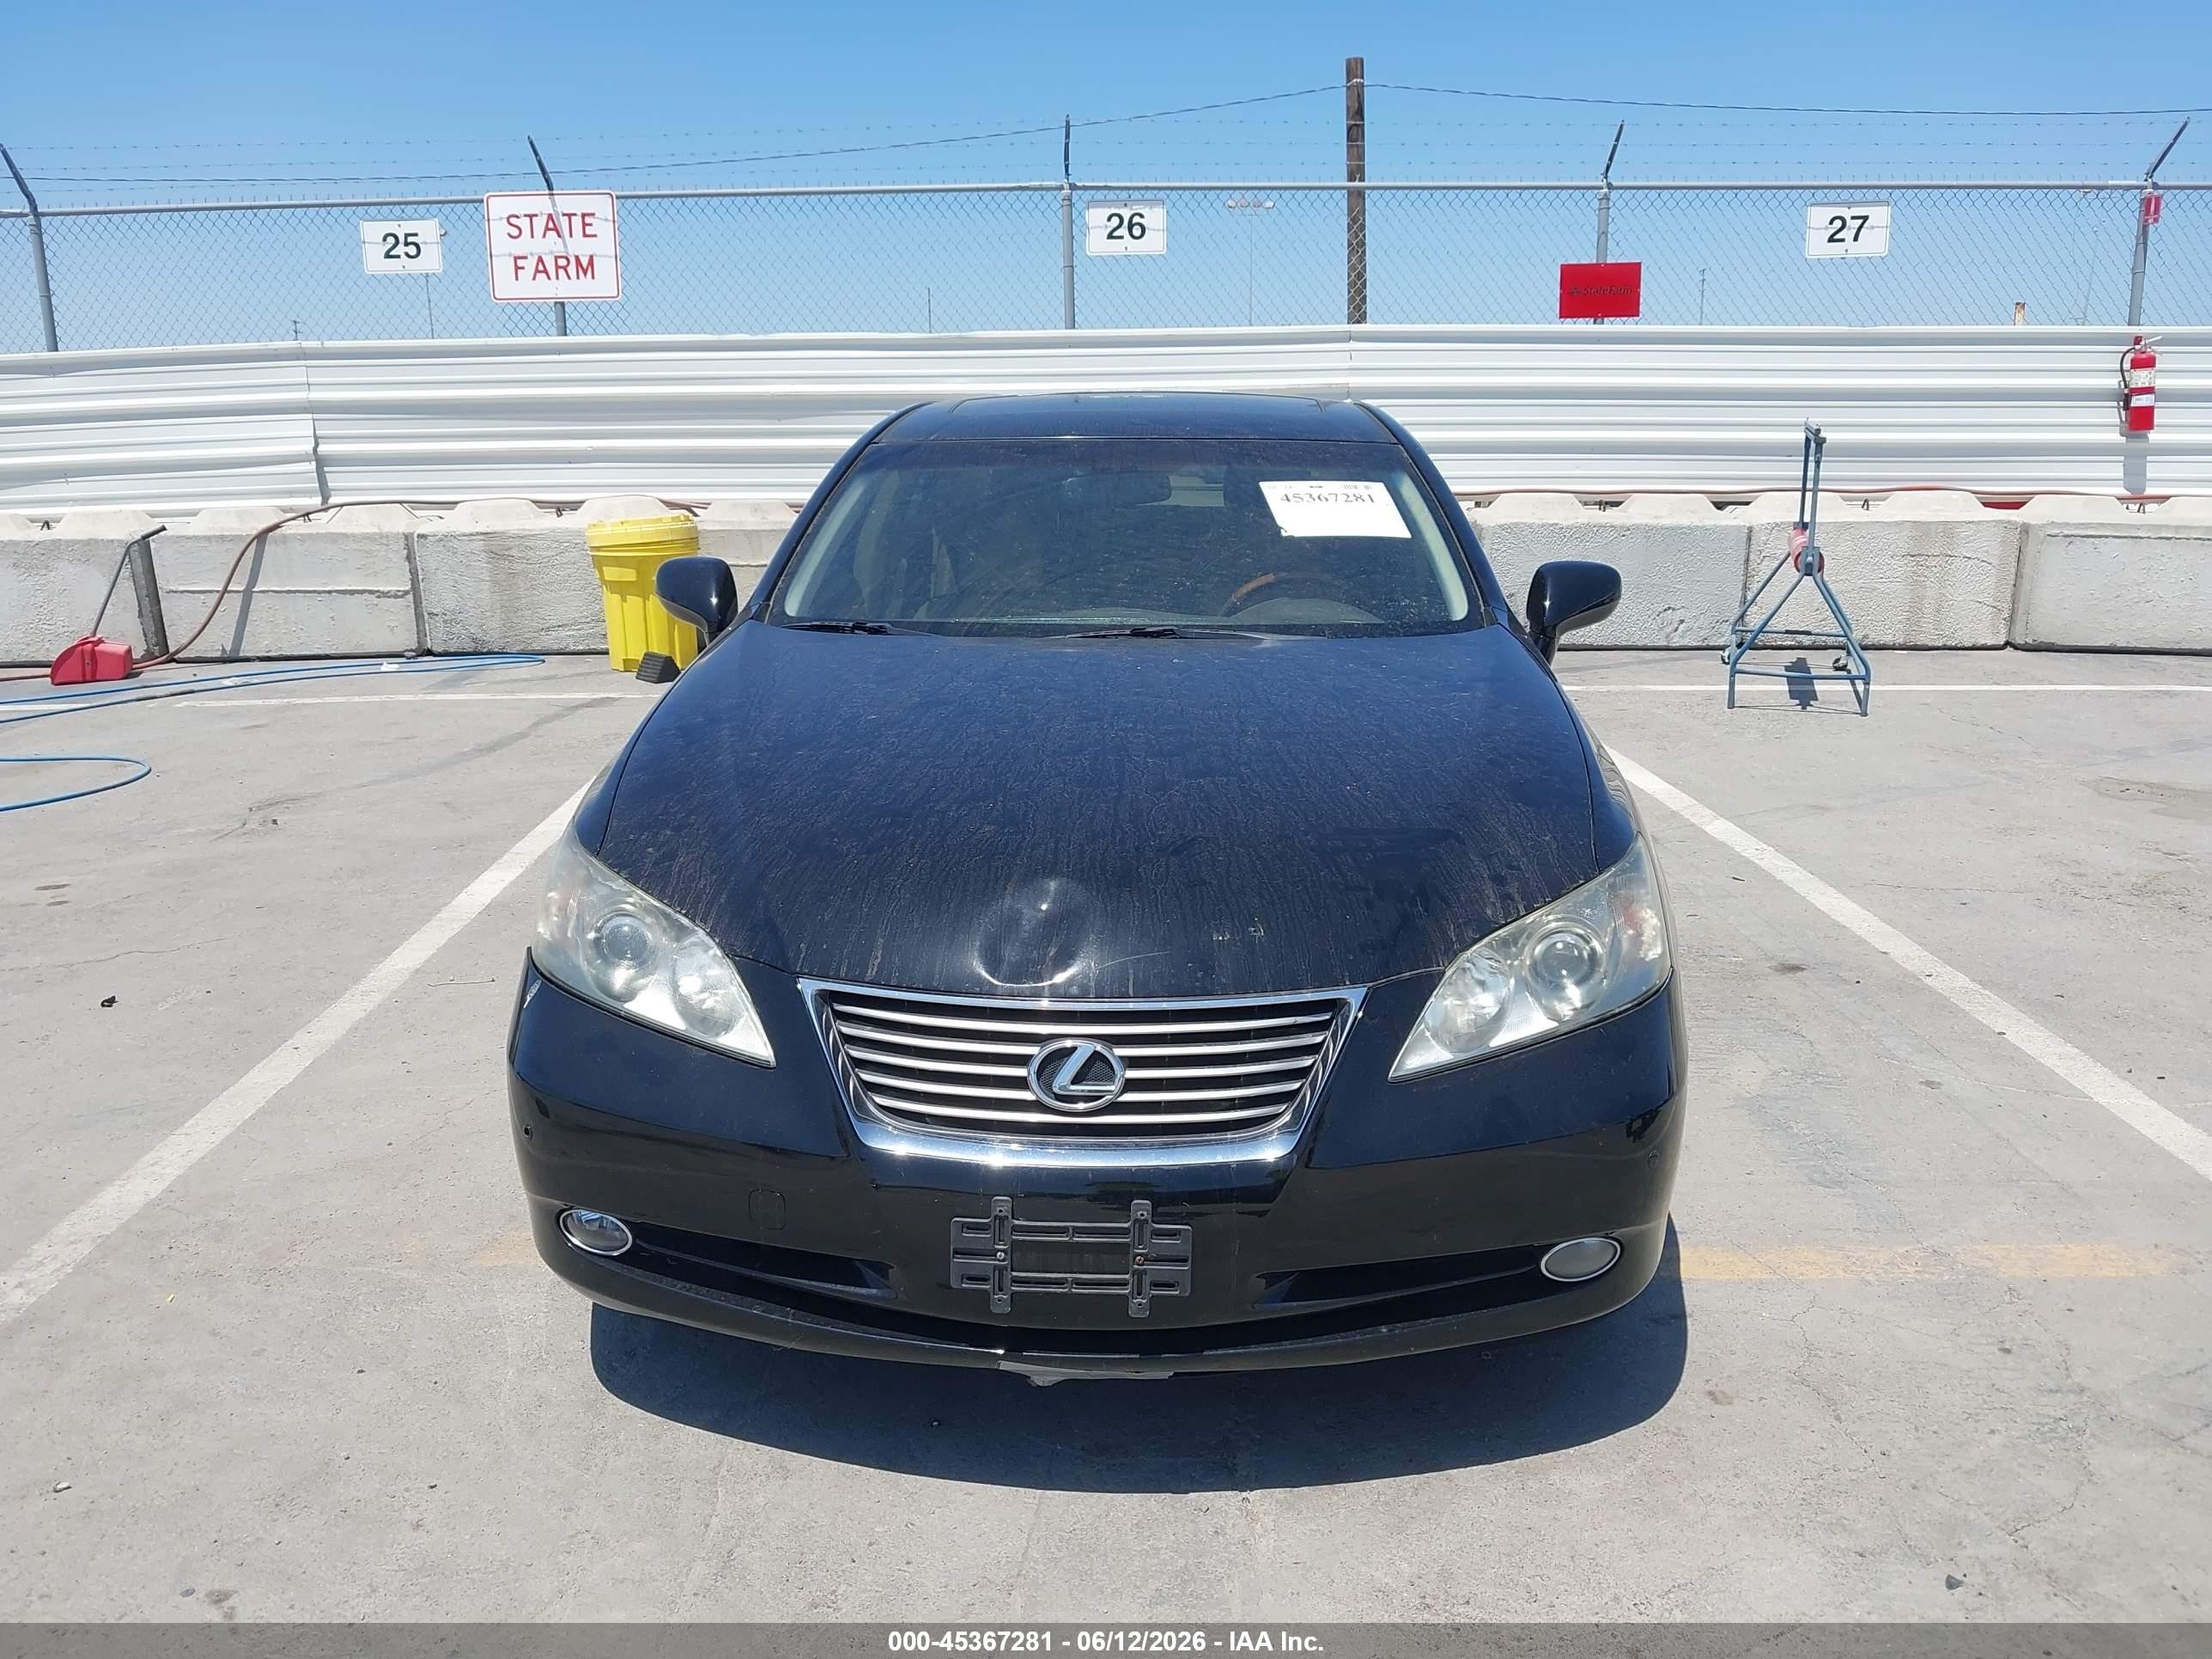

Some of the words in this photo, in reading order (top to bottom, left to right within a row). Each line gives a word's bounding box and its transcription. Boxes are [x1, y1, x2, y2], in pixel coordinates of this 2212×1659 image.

[506, 212, 598, 240] STATE
[1106, 212, 1146, 240] 26
[1826, 215, 1869, 243] 27
[382, 232, 422, 259] 25
[514, 254, 596, 281] FARM
[1280, 493, 1376, 504] 45367281
